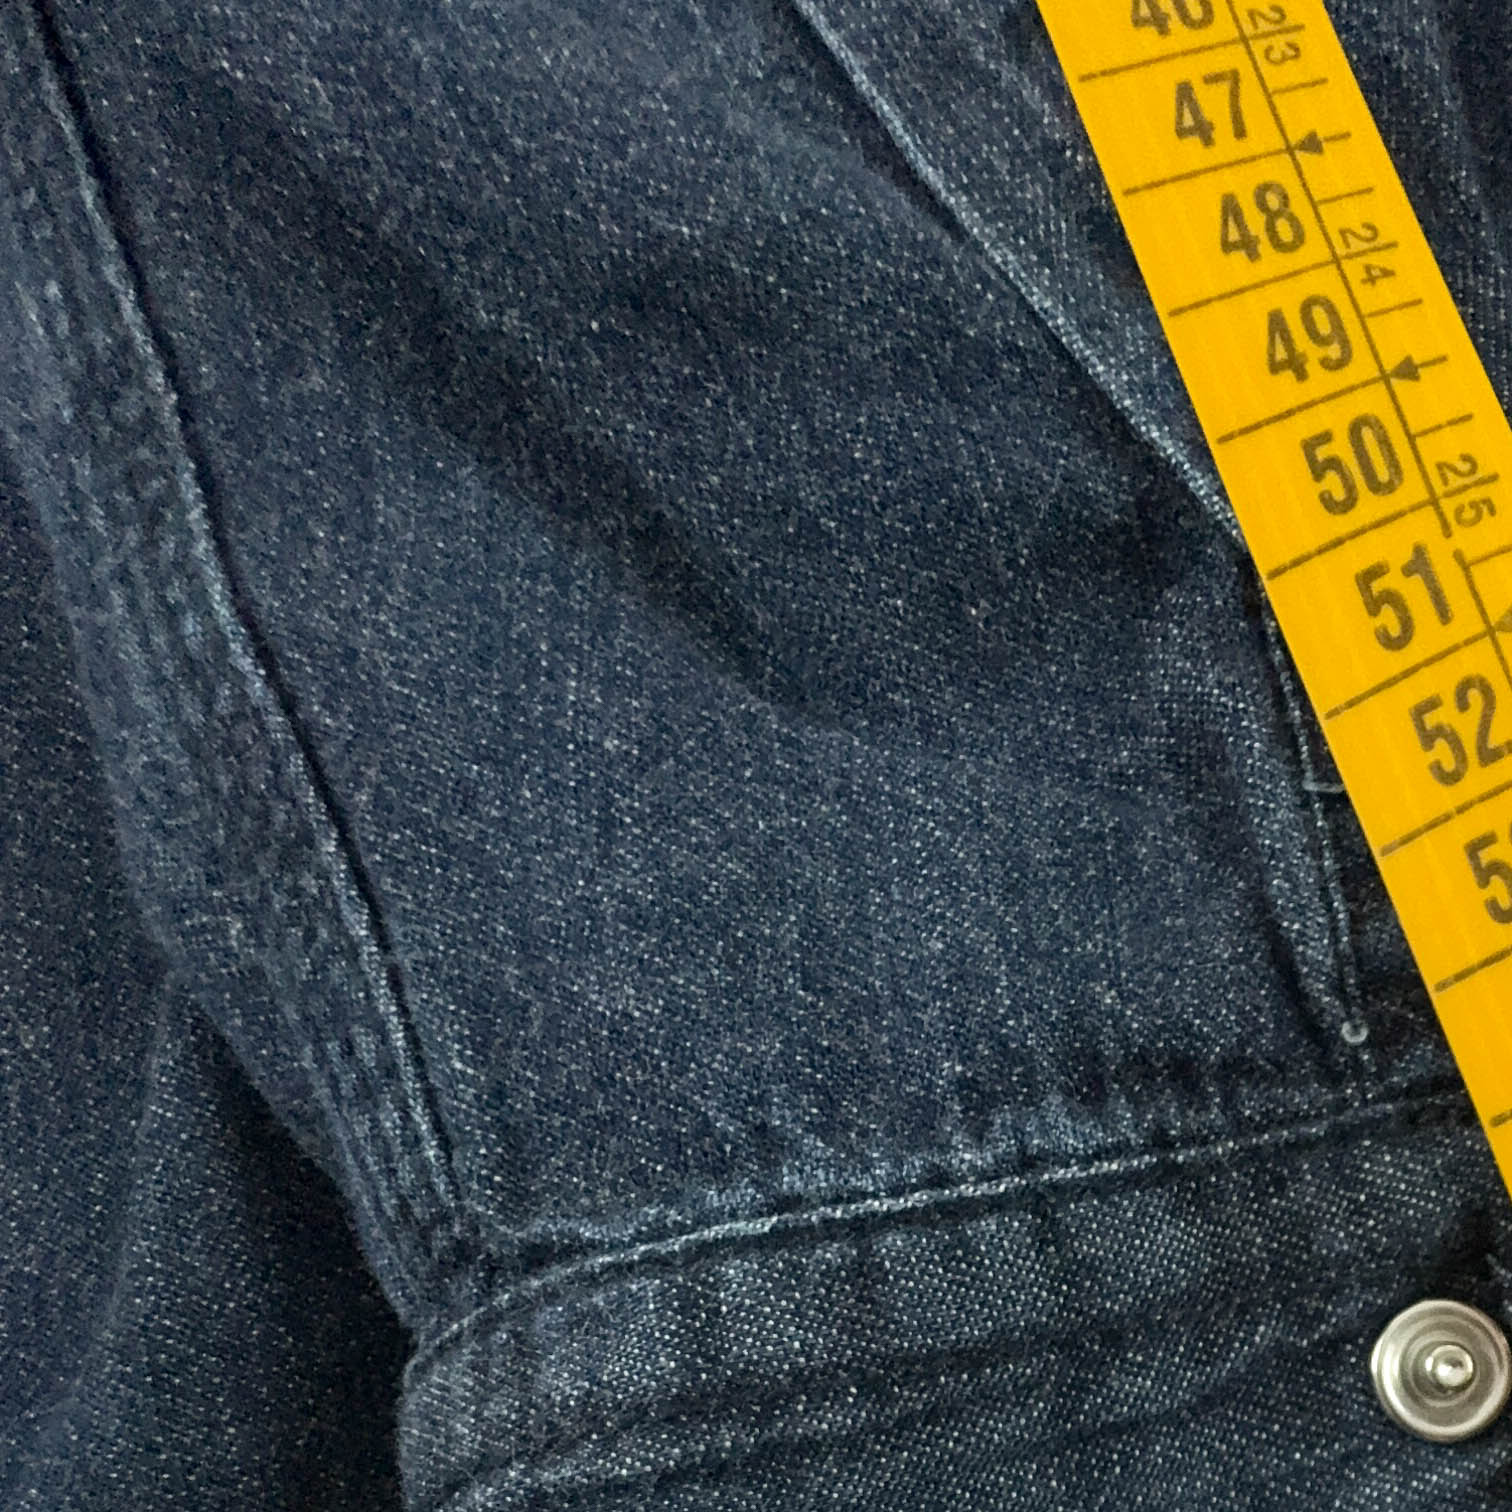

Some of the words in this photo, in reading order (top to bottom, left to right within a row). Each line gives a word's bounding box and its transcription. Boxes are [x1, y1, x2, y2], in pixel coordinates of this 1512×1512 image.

[1247, 4, 1301, 66] 23
[1174, 69, 1248, 149] 47
[1218, 182, 1305, 264] 48
[1339, 222, 1396, 287] 24
[1265, 294, 1353, 383] 49
[1301, 413, 1404, 516] 50
[1435, 454, 1497, 528] 25
[1354, 541, 1454, 652] 51
